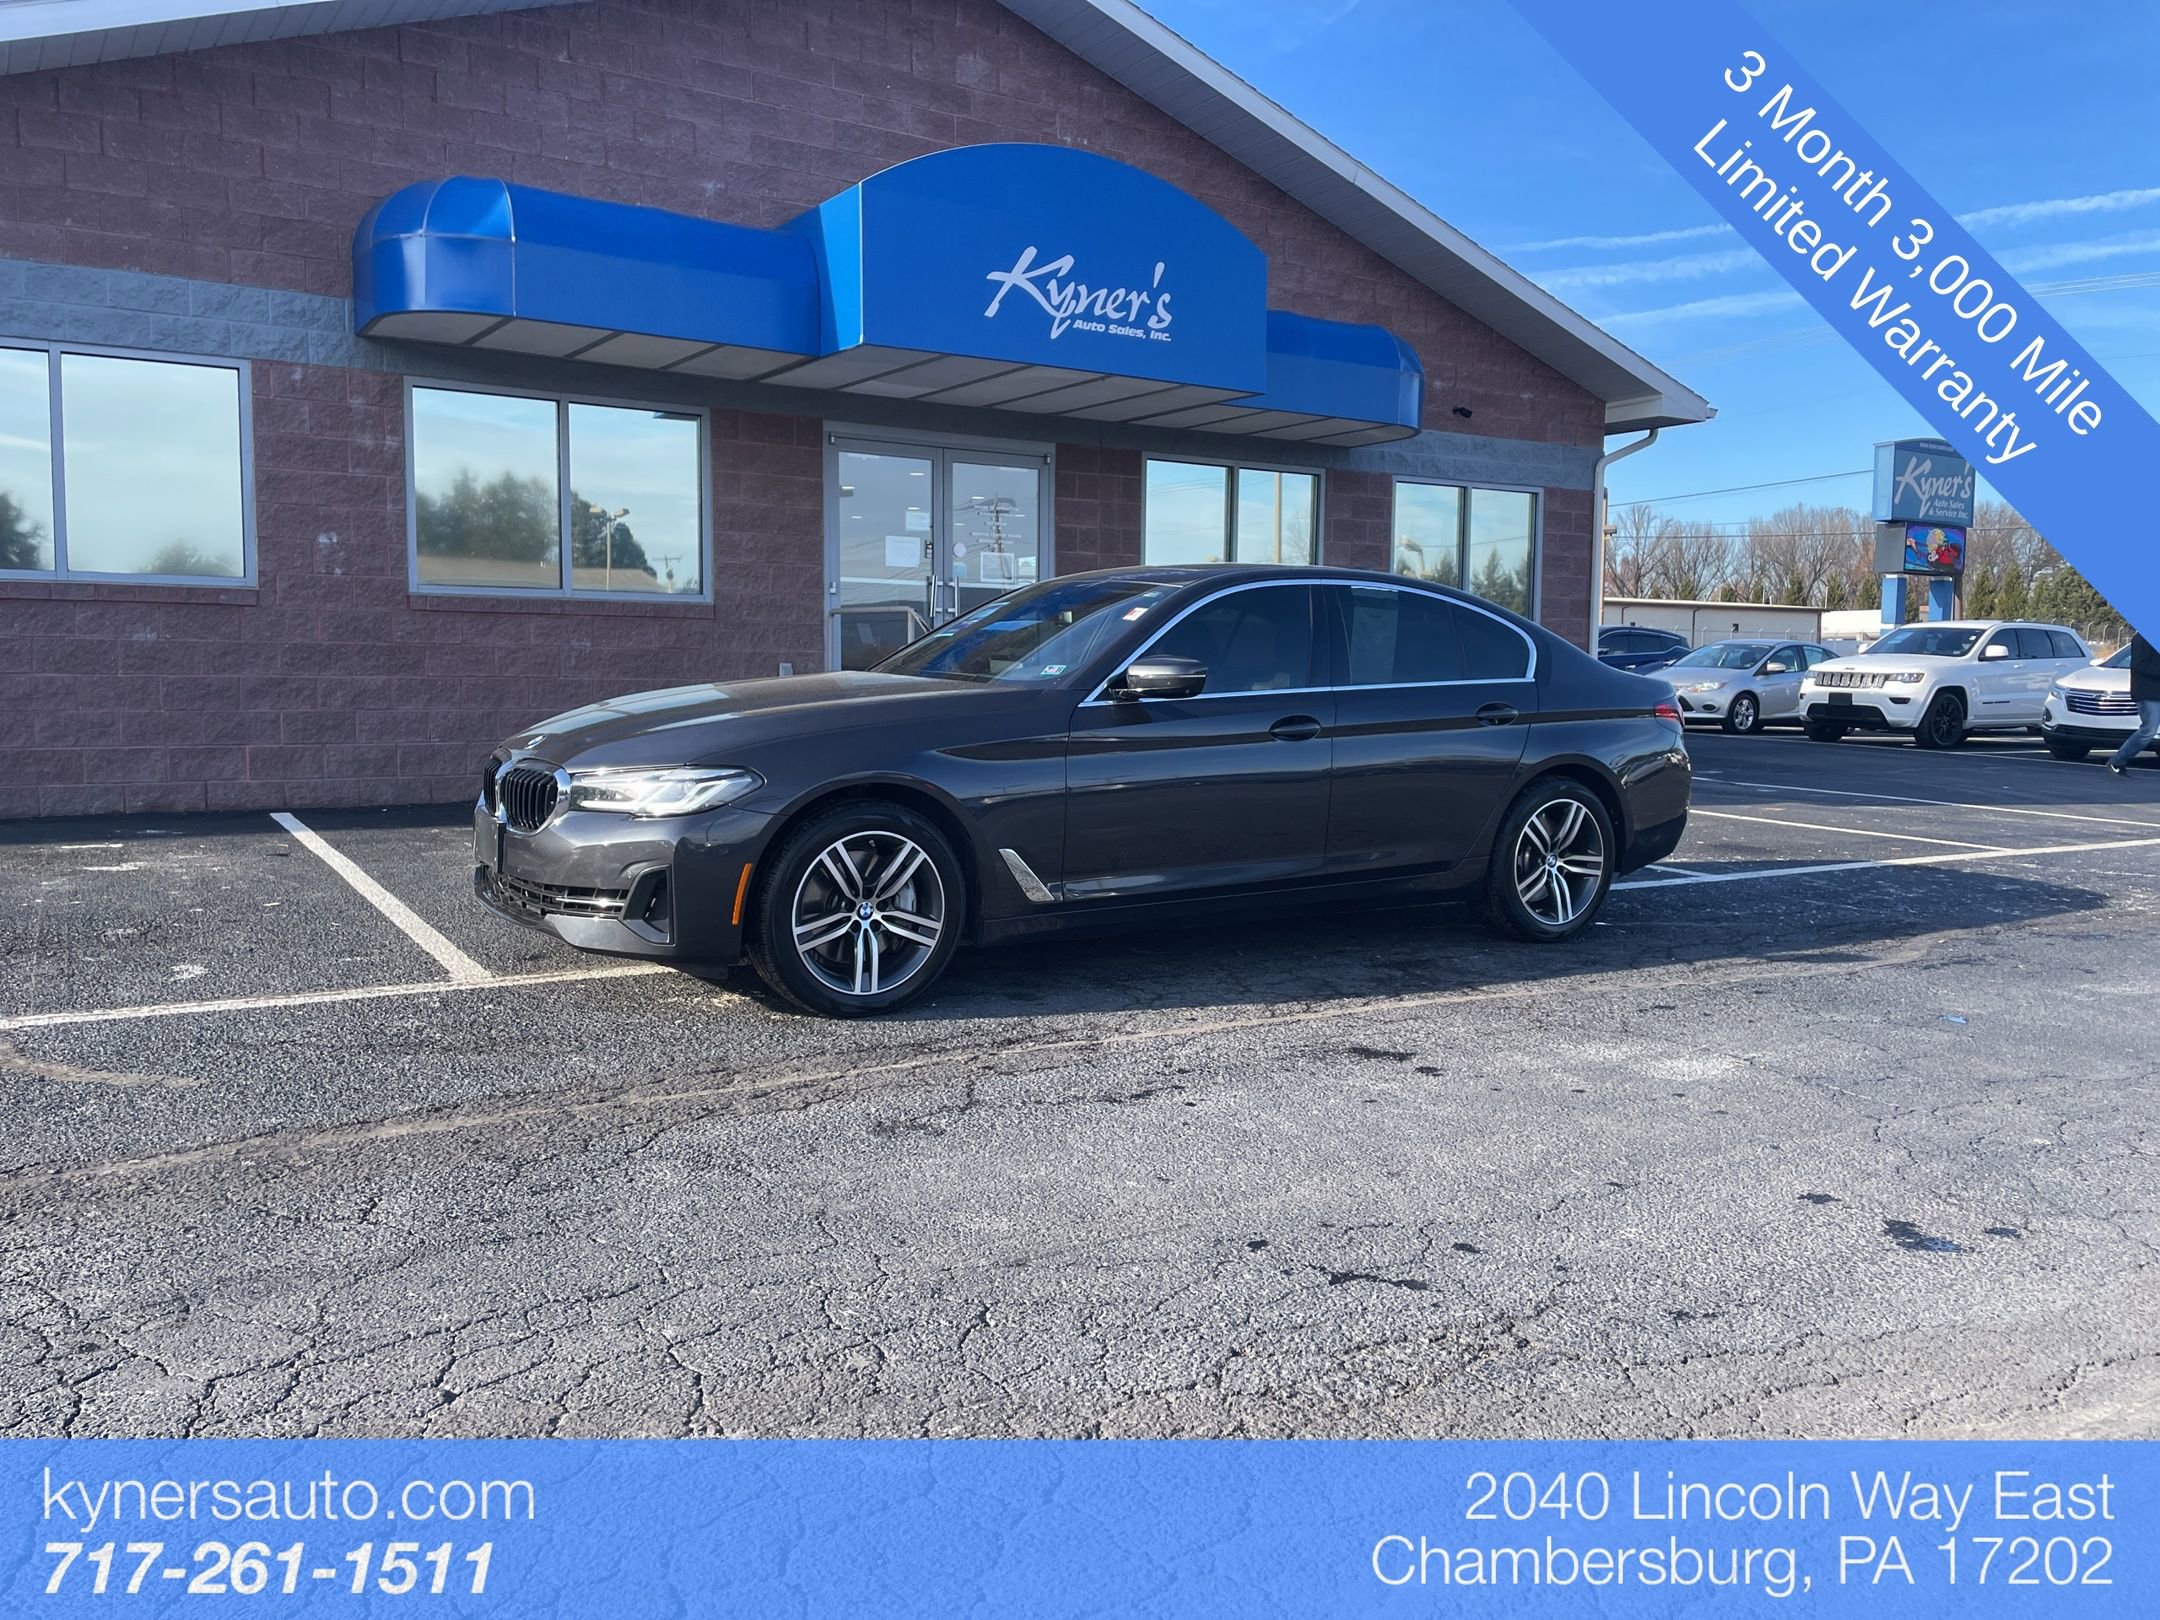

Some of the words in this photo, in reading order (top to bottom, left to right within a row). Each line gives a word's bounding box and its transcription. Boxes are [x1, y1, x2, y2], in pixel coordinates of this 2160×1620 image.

[984, 245, 1173, 340] Kyner's
[1072, 319, 1106, 333] Auto
[1108, 324, 1146, 339] Sales,
[1149, 330, 1172, 342] Inc.
[1894, 456, 1972, 519] Kyner's
[1933, 499, 1949, 508] Auto
[1949, 500, 1965, 509] Sales
[1935, 508, 1958, 518] Service
